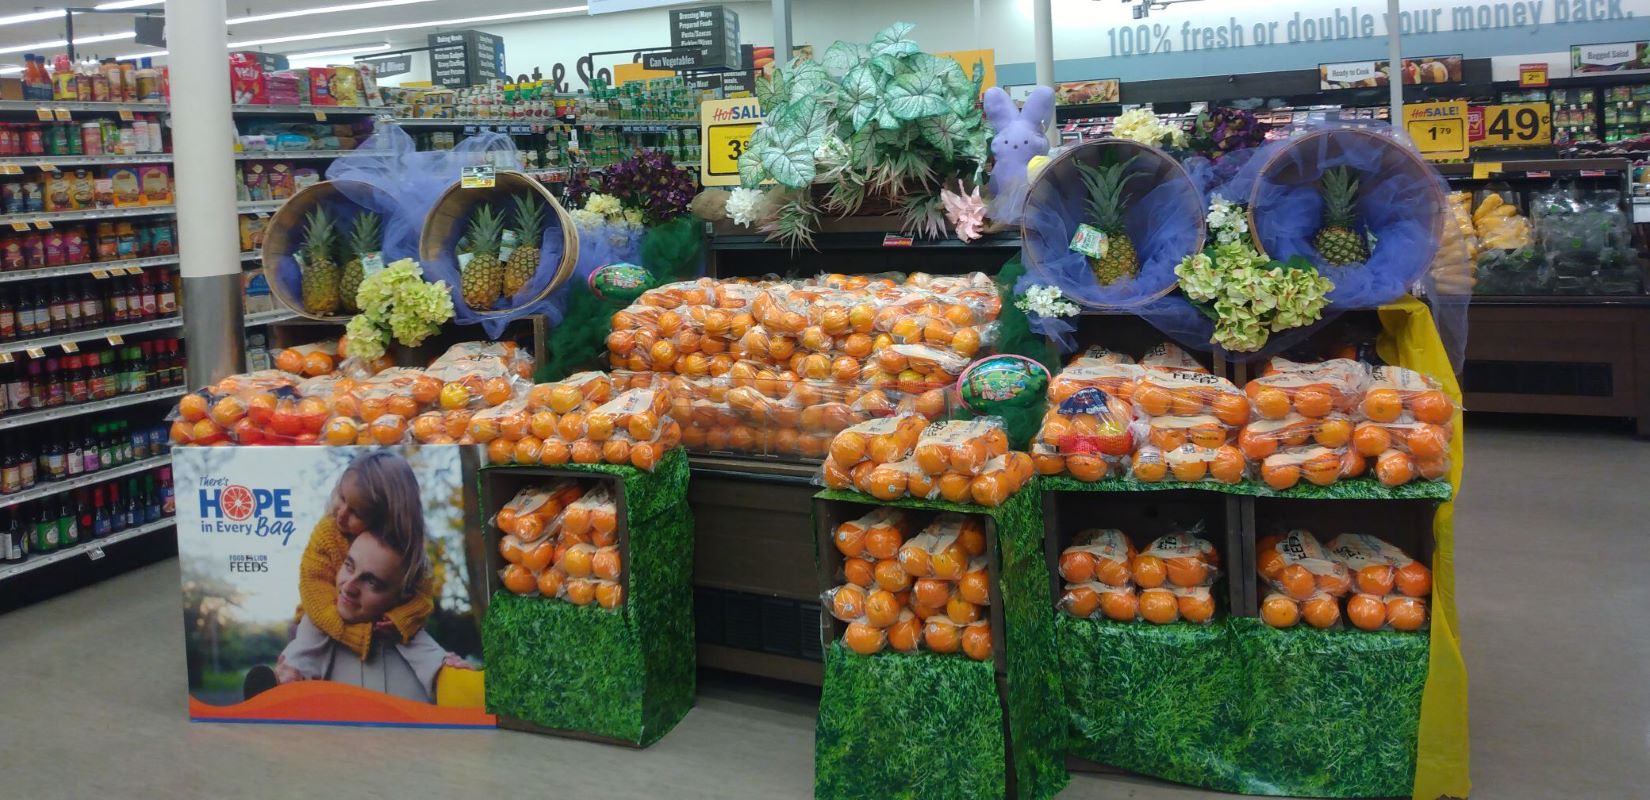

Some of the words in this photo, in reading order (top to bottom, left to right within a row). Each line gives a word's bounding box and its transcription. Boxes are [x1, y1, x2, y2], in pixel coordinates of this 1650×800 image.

[1107, 23, 1171, 57] 100%
[1180, 17, 1244, 51] fresh
[1253, 20, 1279, 46] or
[1287, 6, 1375, 43] double
[1452, 2, 1543, 35] money
[650, 57, 662, 68] Can
[662, 56, 695, 68] Vegetables
[199, 475, 229, 486] There's
[199, 485, 293, 521] HOPE
[201, 520, 213, 533] in
[216, 521, 252, 536] Every
[255, 516, 296, 546] Bag
[229, 561, 269, 573] FEEDS
